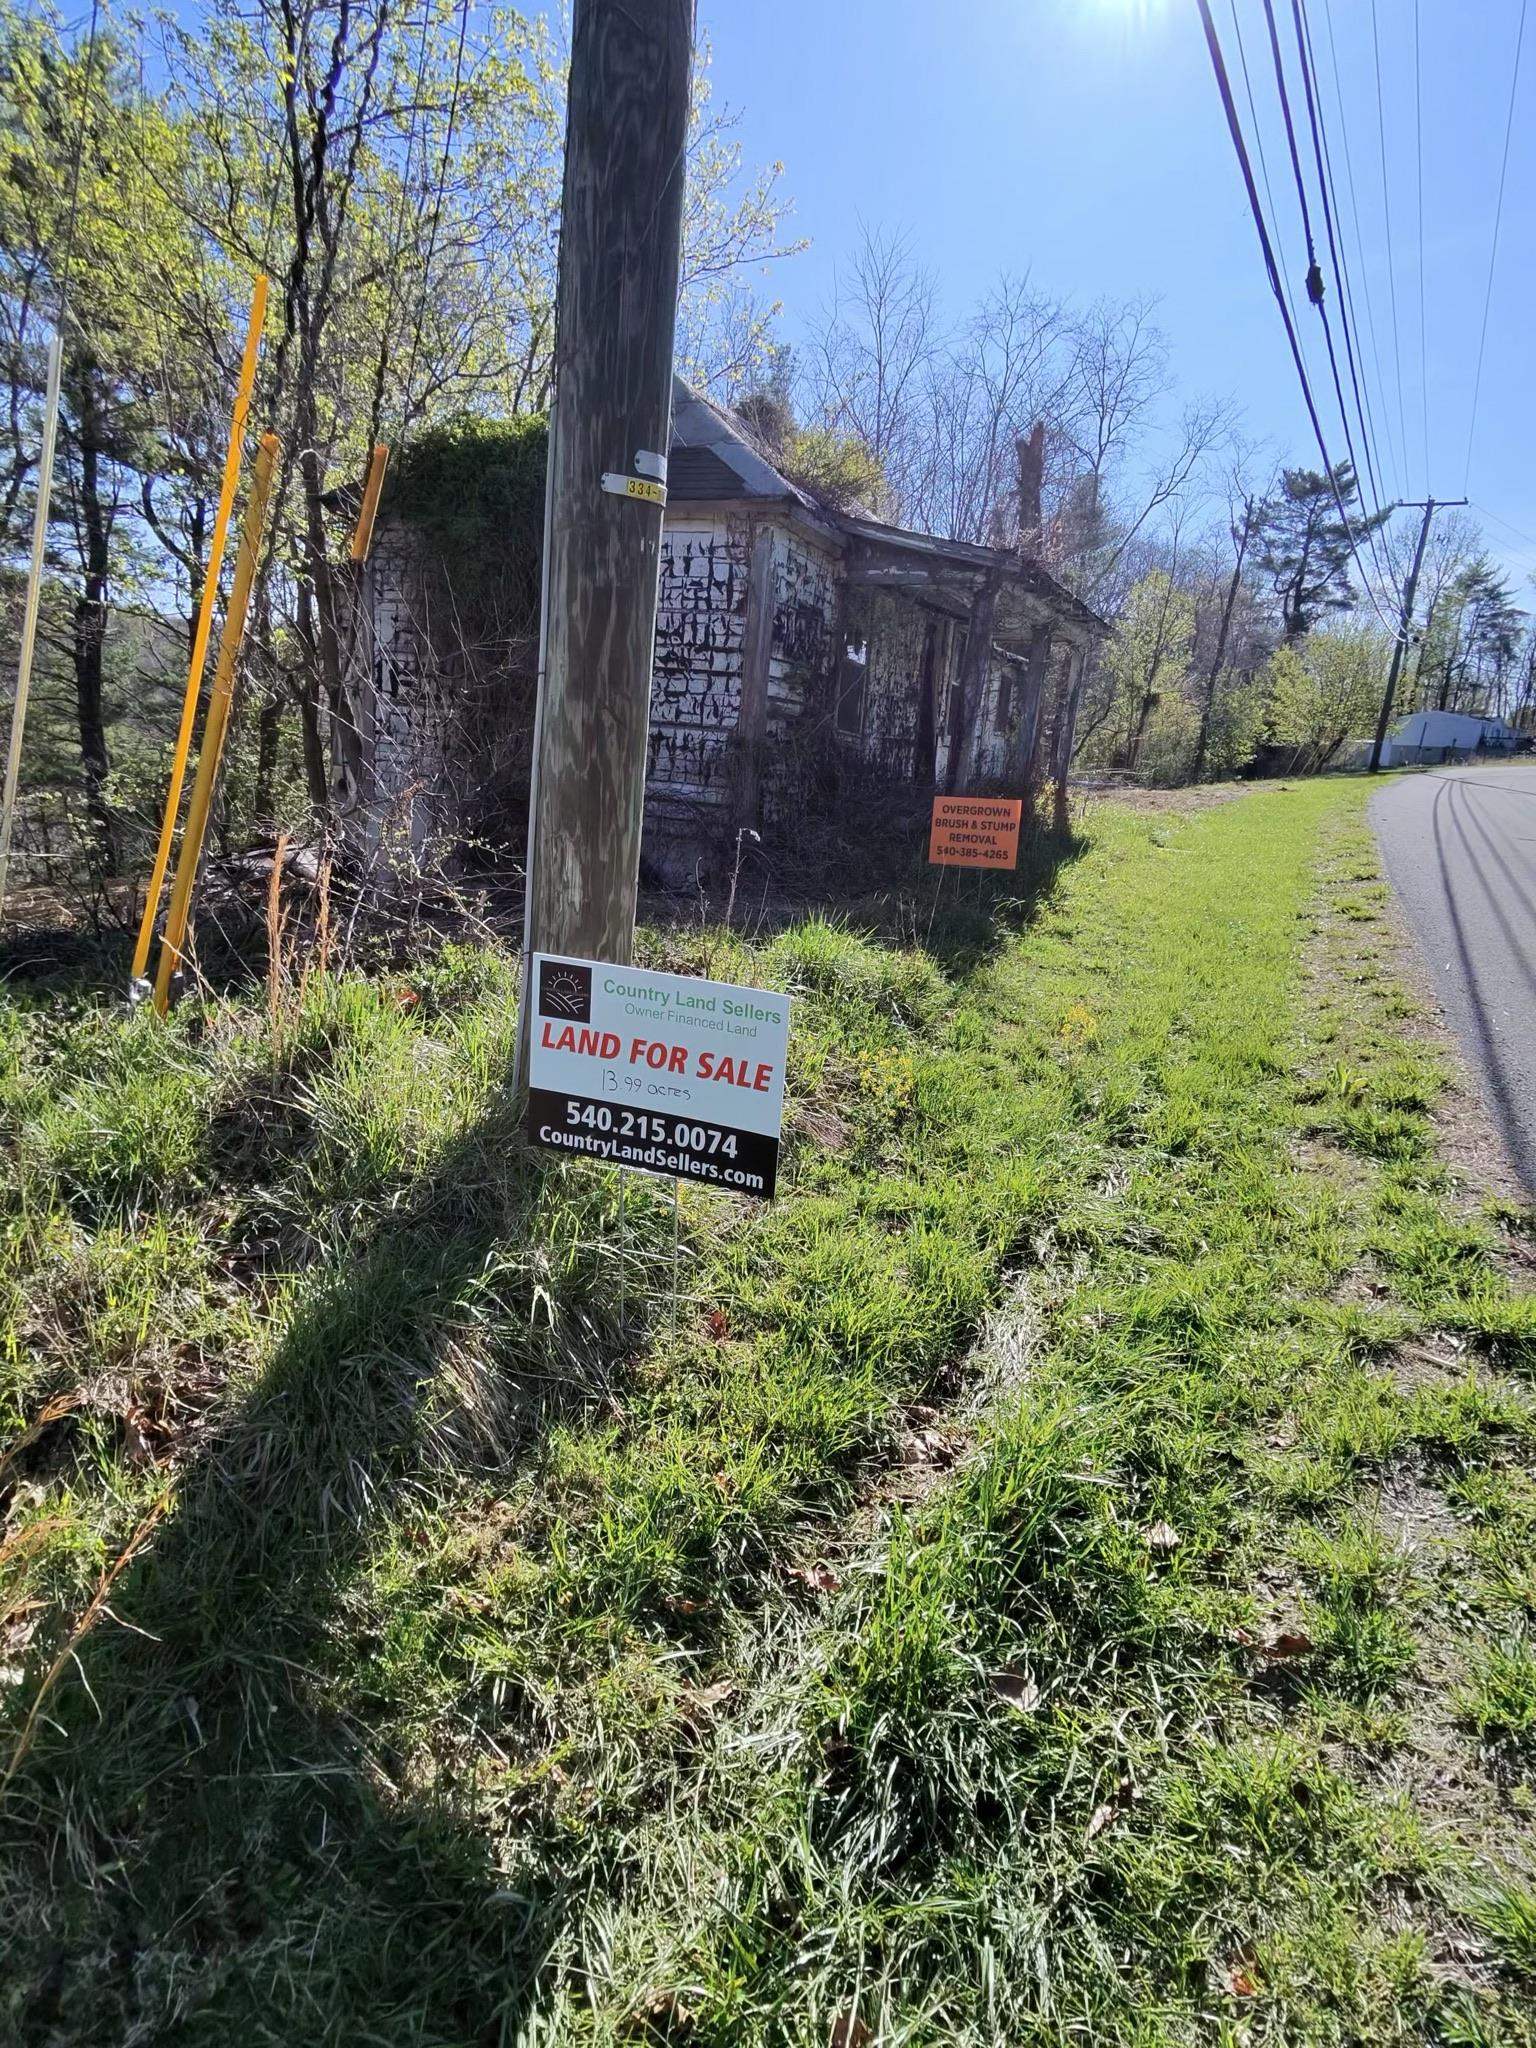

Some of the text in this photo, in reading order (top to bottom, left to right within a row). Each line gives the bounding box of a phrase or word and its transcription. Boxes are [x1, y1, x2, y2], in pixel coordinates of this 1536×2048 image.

[942, 805, 1011, 817] OVERGROWN
[935, 818, 1016, 832] BRUSH & STUMP
[949, 833, 997, 845] REMOVAL
[937, 846, 1009, 860] 540-385-4265
[604, 979, 781, 1024] Country Land Sellers
[625, 1003, 757, 1037] Owner Financed Land
[541, 1022, 774, 1092] LAND FOR SALE
[647, 1084, 691, 1100] acres
[566, 1101, 738, 1159] 540.215.0074
[539, 1126, 764, 1190] CountryLandSellers.com
